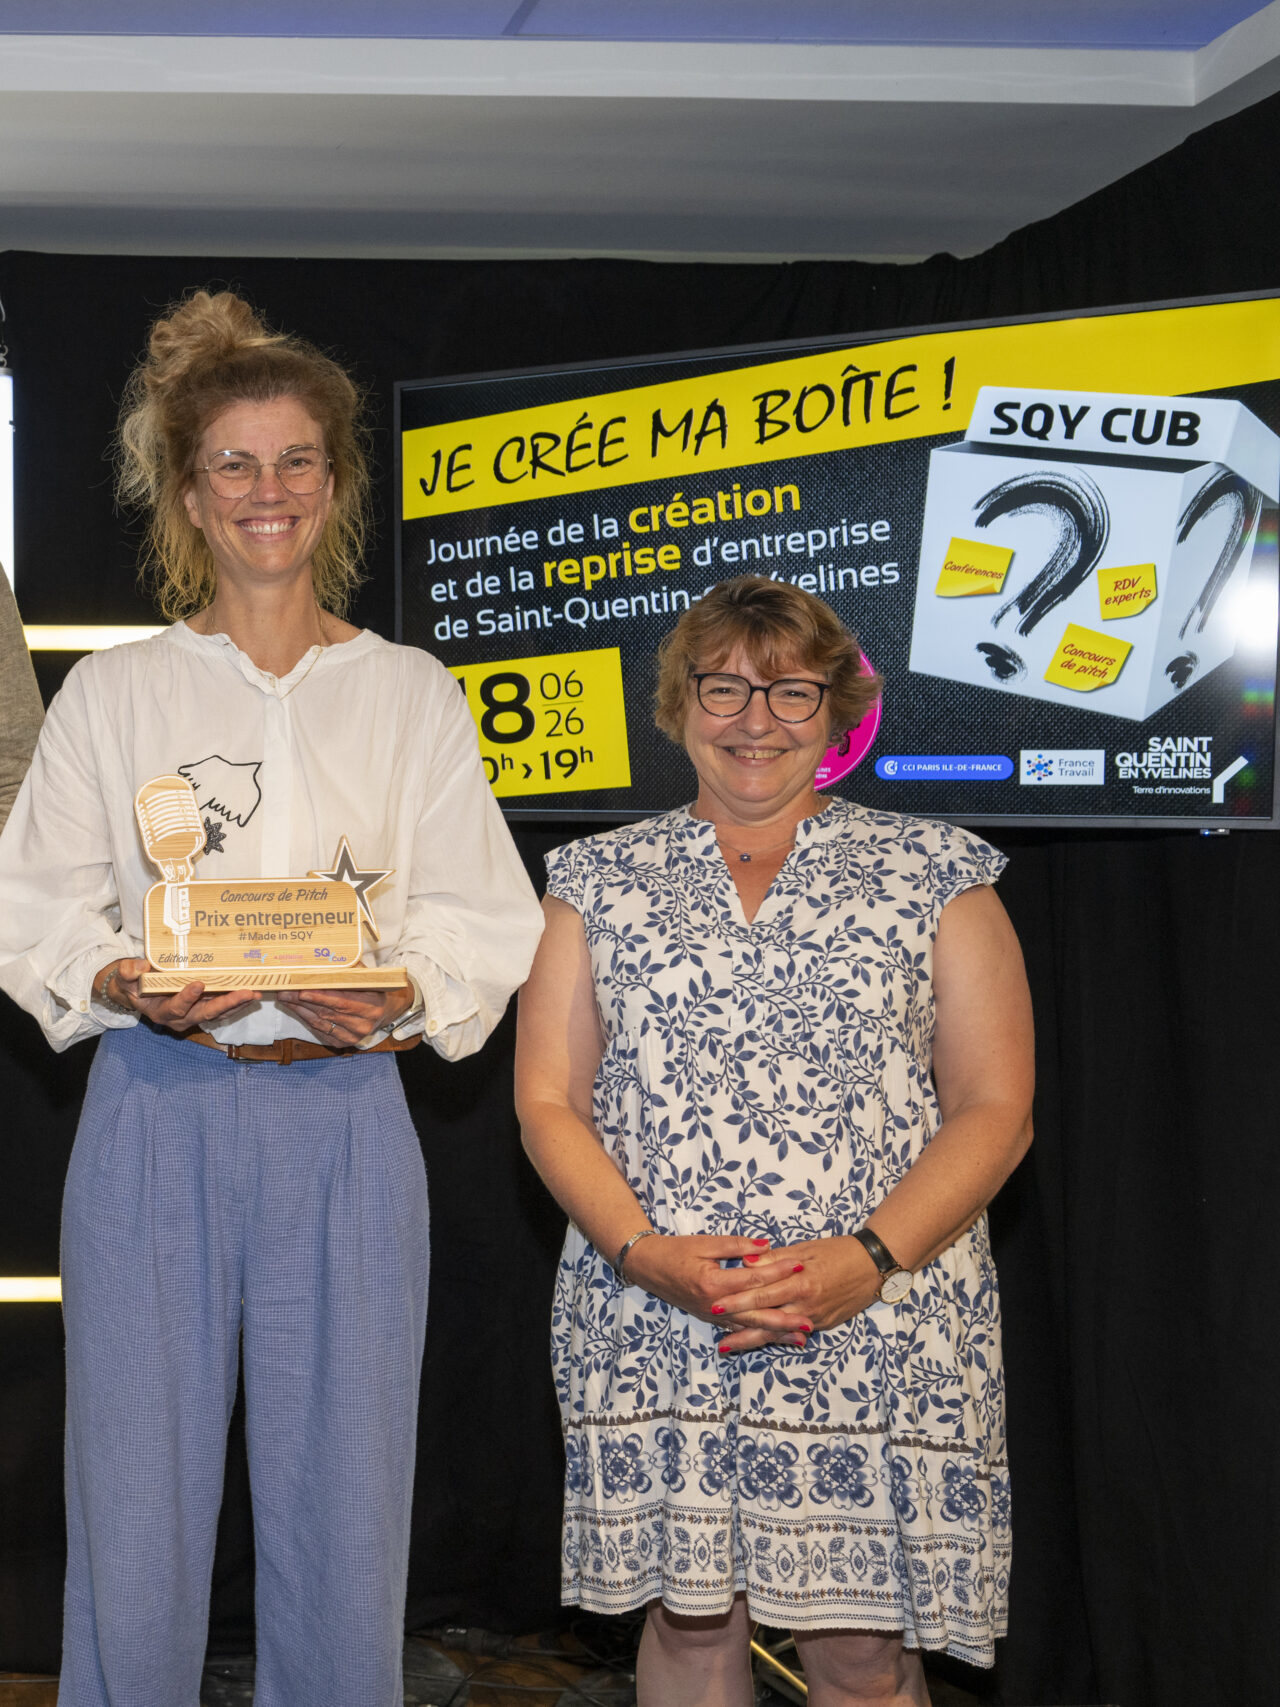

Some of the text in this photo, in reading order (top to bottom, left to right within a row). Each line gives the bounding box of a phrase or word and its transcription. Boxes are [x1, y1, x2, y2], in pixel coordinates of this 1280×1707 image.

[419, 355, 956, 497] JE CRÉE MA BOÎTE !
[989, 400, 1202, 447] SQY CUB
[426, 483, 801, 566] Journée de la création
[430, 517, 891, 602] et de la reprise d'entreprise
[943, 560, 1005, 581] Conférences
[1113, 576, 1142, 592] RDV
[1104, 587, 1152, 606] experts
[434, 612, 470, 641] de
[1062, 643, 1117, 667] Concours
[1060, 657, 1109, 680] de pitch
[539, 669, 584, 700] 06
[457, 671, 536, 745] 8
[544, 707, 585, 738] 26
[1148, 736, 1213, 752] SAINT
[902, 763, 1003, 772] CCI PARIS ILE-DE-FRANCE
[1058, 758, 1095, 768] France
[1115, 752, 1212, 768] QUENTIN
[1058, 768, 1095, 777] Travail
[1118, 767, 1212, 779] EN YVELINES
[1132, 785, 1211, 794] Terre d'innovations
[220, 887, 328, 903] Concours de Pitch
[195, 909, 355, 929] Prix entrepreneur
[279, 931, 288, 940] in
[290, 930, 314, 940] SQY
[158, 952, 214, 963] Edition 2026
